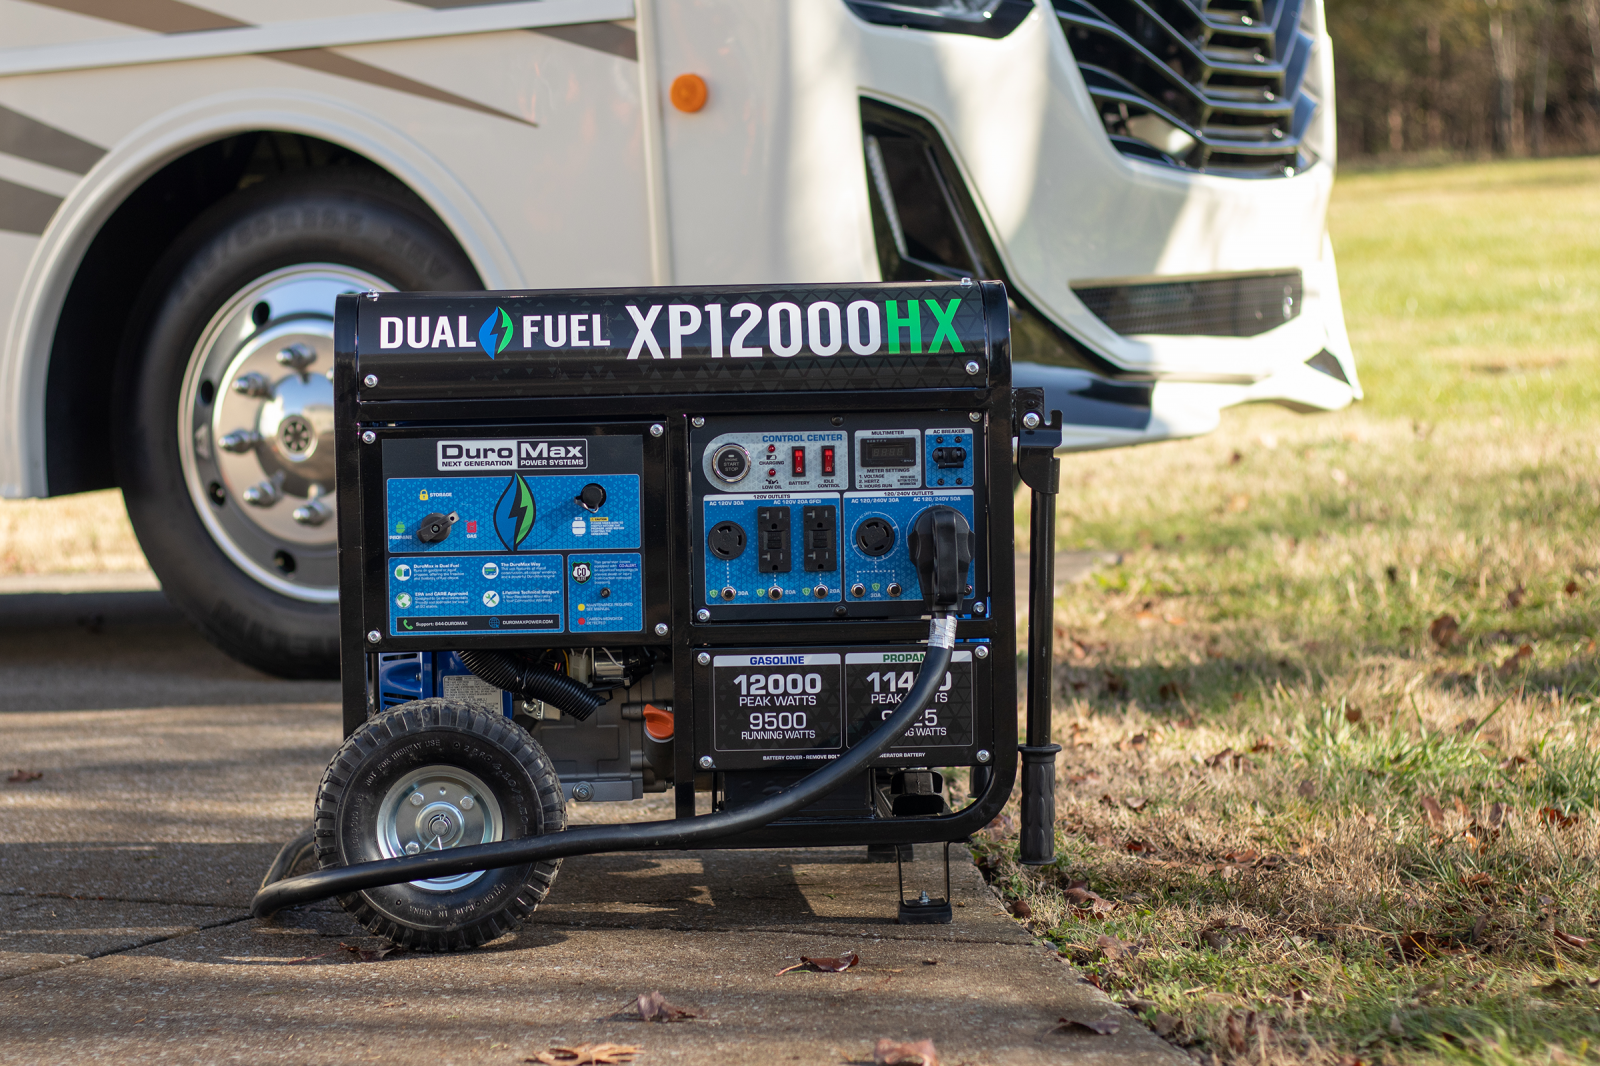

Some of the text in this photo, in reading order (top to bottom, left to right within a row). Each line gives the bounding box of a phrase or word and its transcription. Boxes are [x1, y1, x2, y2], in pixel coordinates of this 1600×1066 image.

[380, 299, 965, 360] DUAL FUEL XP12000HX
[762, 434, 843, 442] CONTROL CENTER
[442, 442, 583, 459] Duro Max
[577, 568, 586, 576] CO
[750, 656, 805, 665] GASOLINE
[882, 654, 926, 662] PROPAN
[733, 673, 822, 695] 12000
[739, 695, 817, 707] PEAK WATTS
[871, 693, 902, 704] PEAK
[749, 712, 806, 730] 9500
[741, 730, 816, 740] RUNNING WATTS
[916, 728, 947, 736] WATTS
